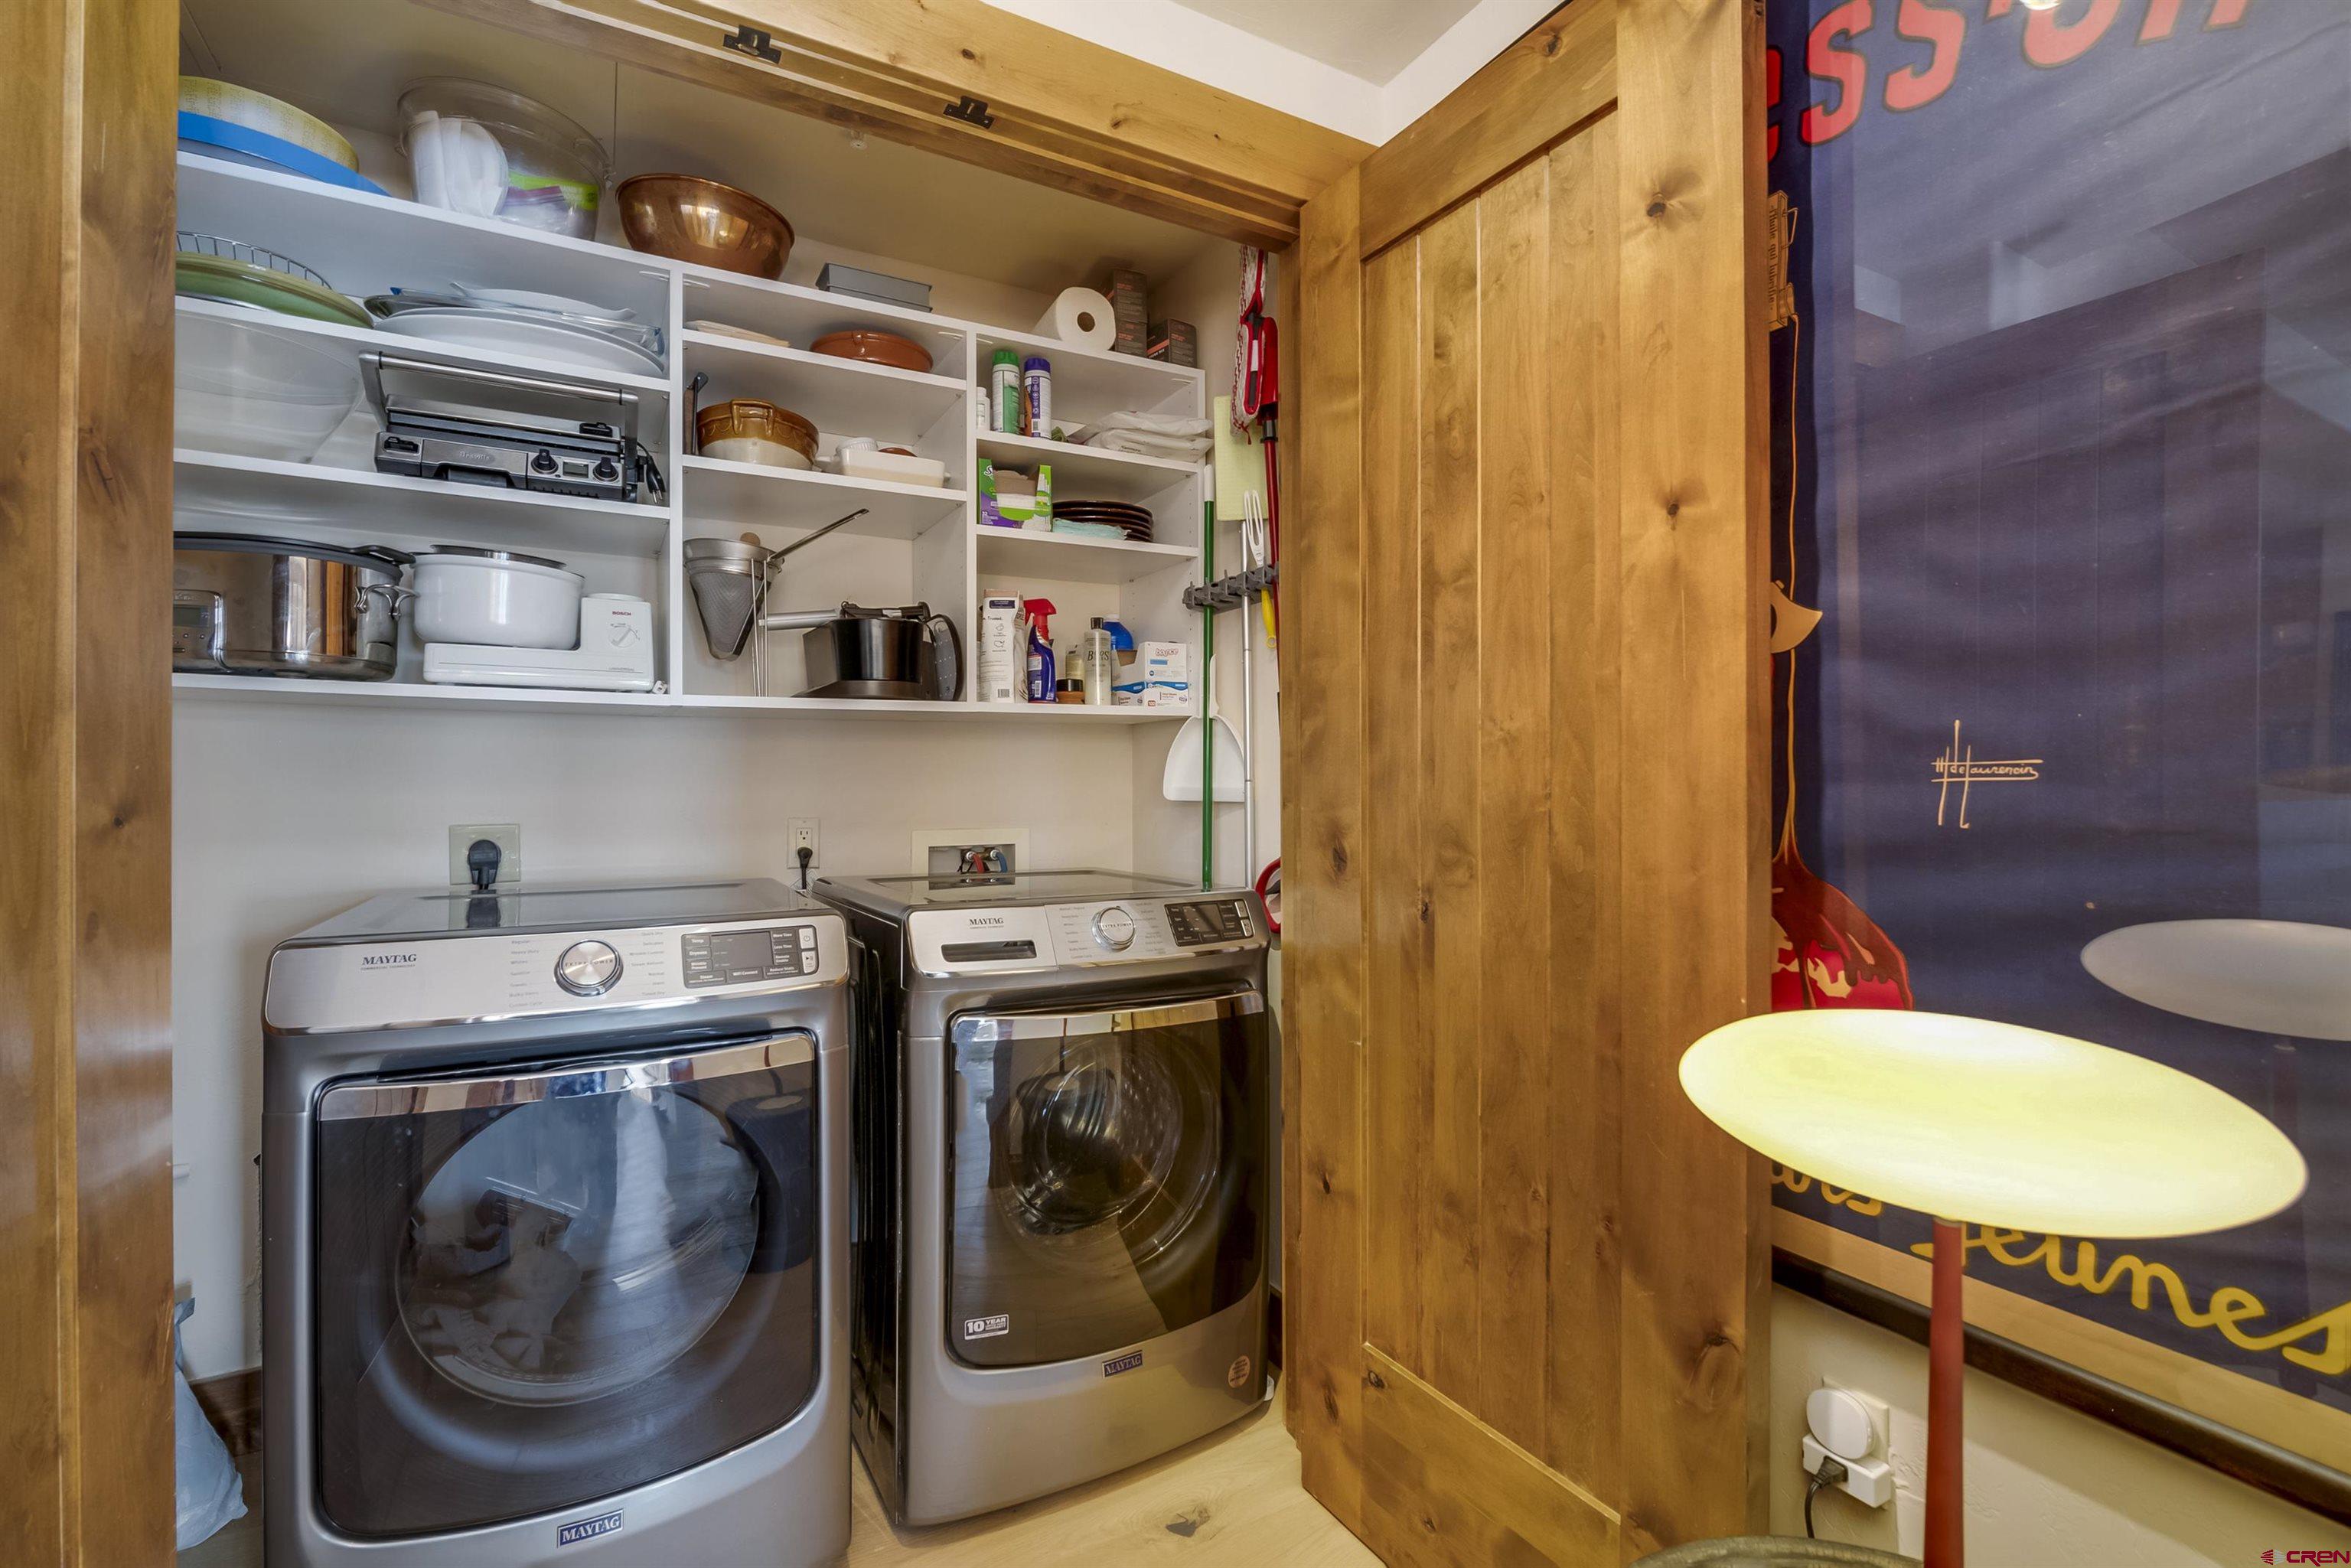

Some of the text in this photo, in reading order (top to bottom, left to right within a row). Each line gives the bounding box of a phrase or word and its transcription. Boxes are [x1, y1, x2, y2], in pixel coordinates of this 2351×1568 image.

[362, 954, 417, 965] MAYTAG
[967, 1321, 984, 1334] 10
[1105, 1355, 1141, 1375] MAYTAG
[562, 1516, 621, 1543] MAYTAG
